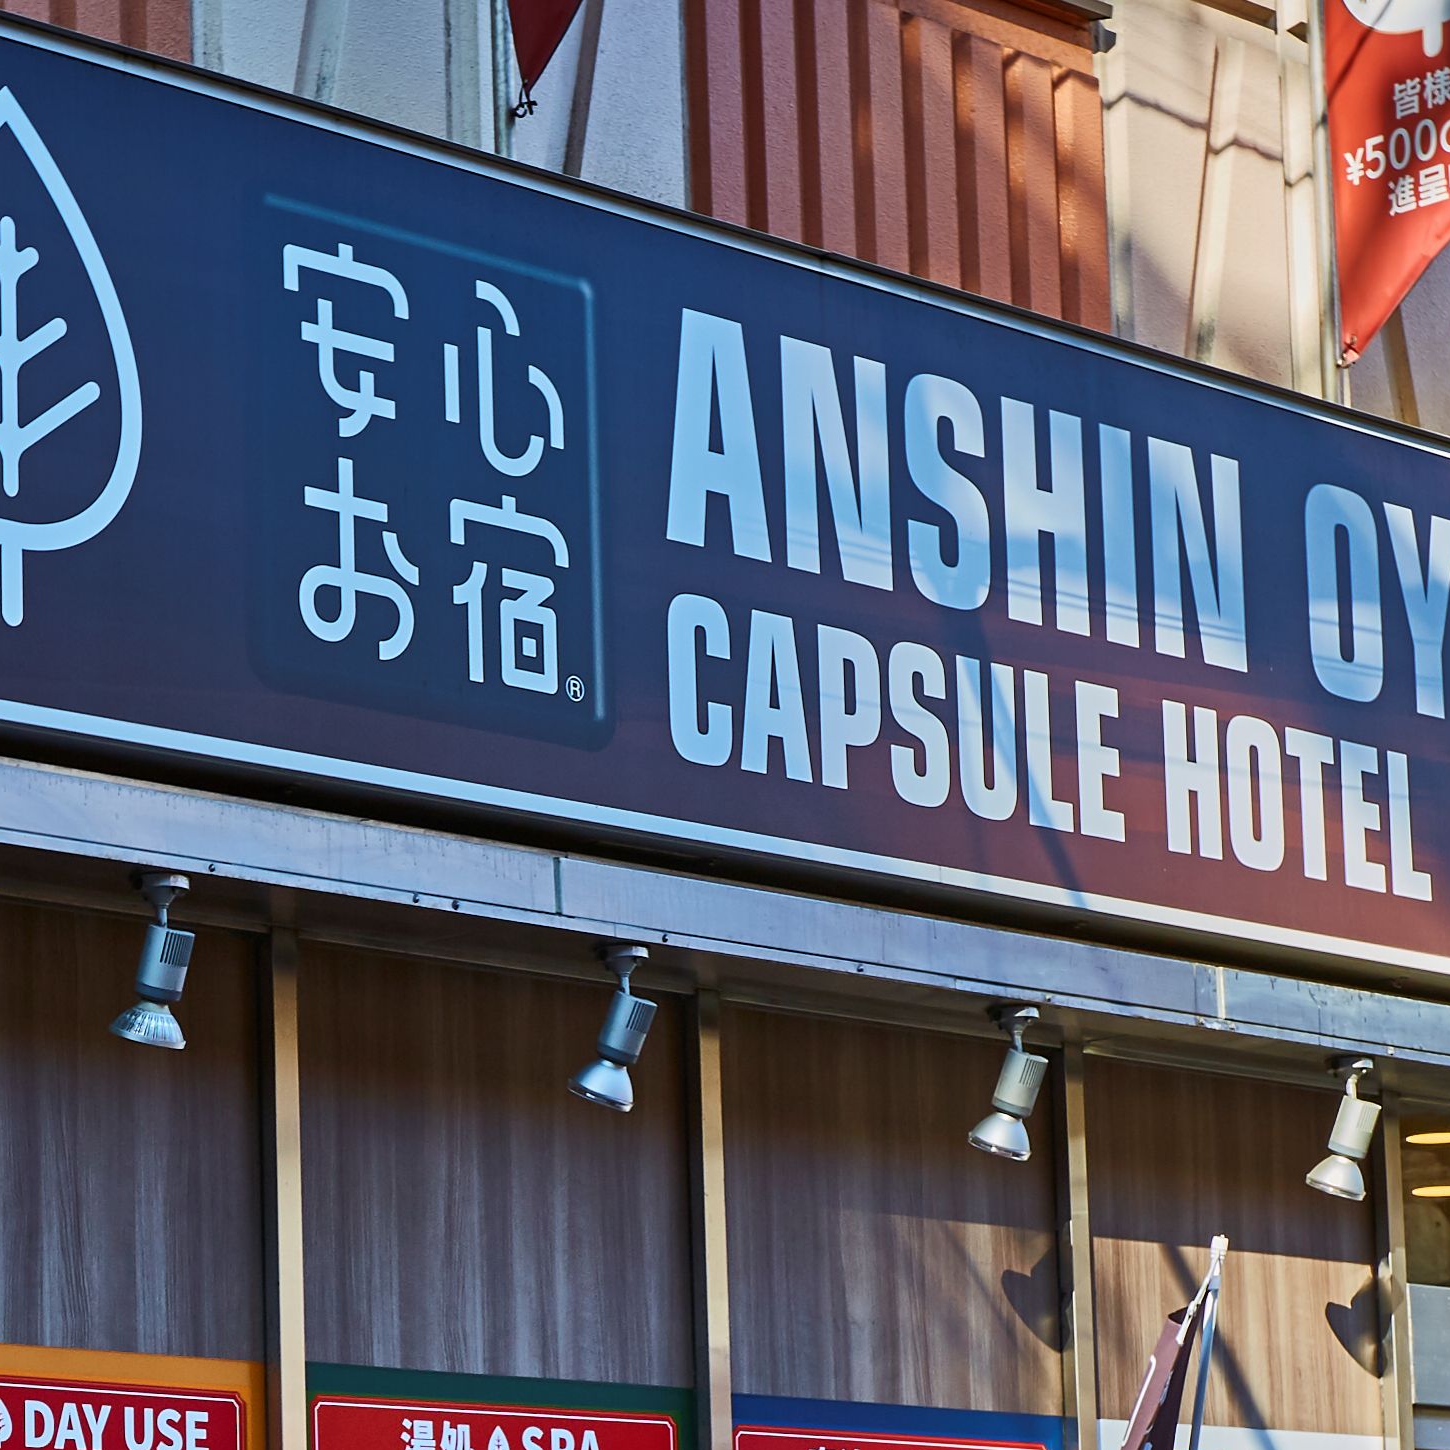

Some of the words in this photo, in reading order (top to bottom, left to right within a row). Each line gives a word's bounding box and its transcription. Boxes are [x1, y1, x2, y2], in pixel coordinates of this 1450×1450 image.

[283, 242, 565, 478] 安心
[667, 308, 1247, 673] ANSHIN
[667, 593, 1126, 844] CAPSULE
[1162, 699, 1433, 903] HOTEL
